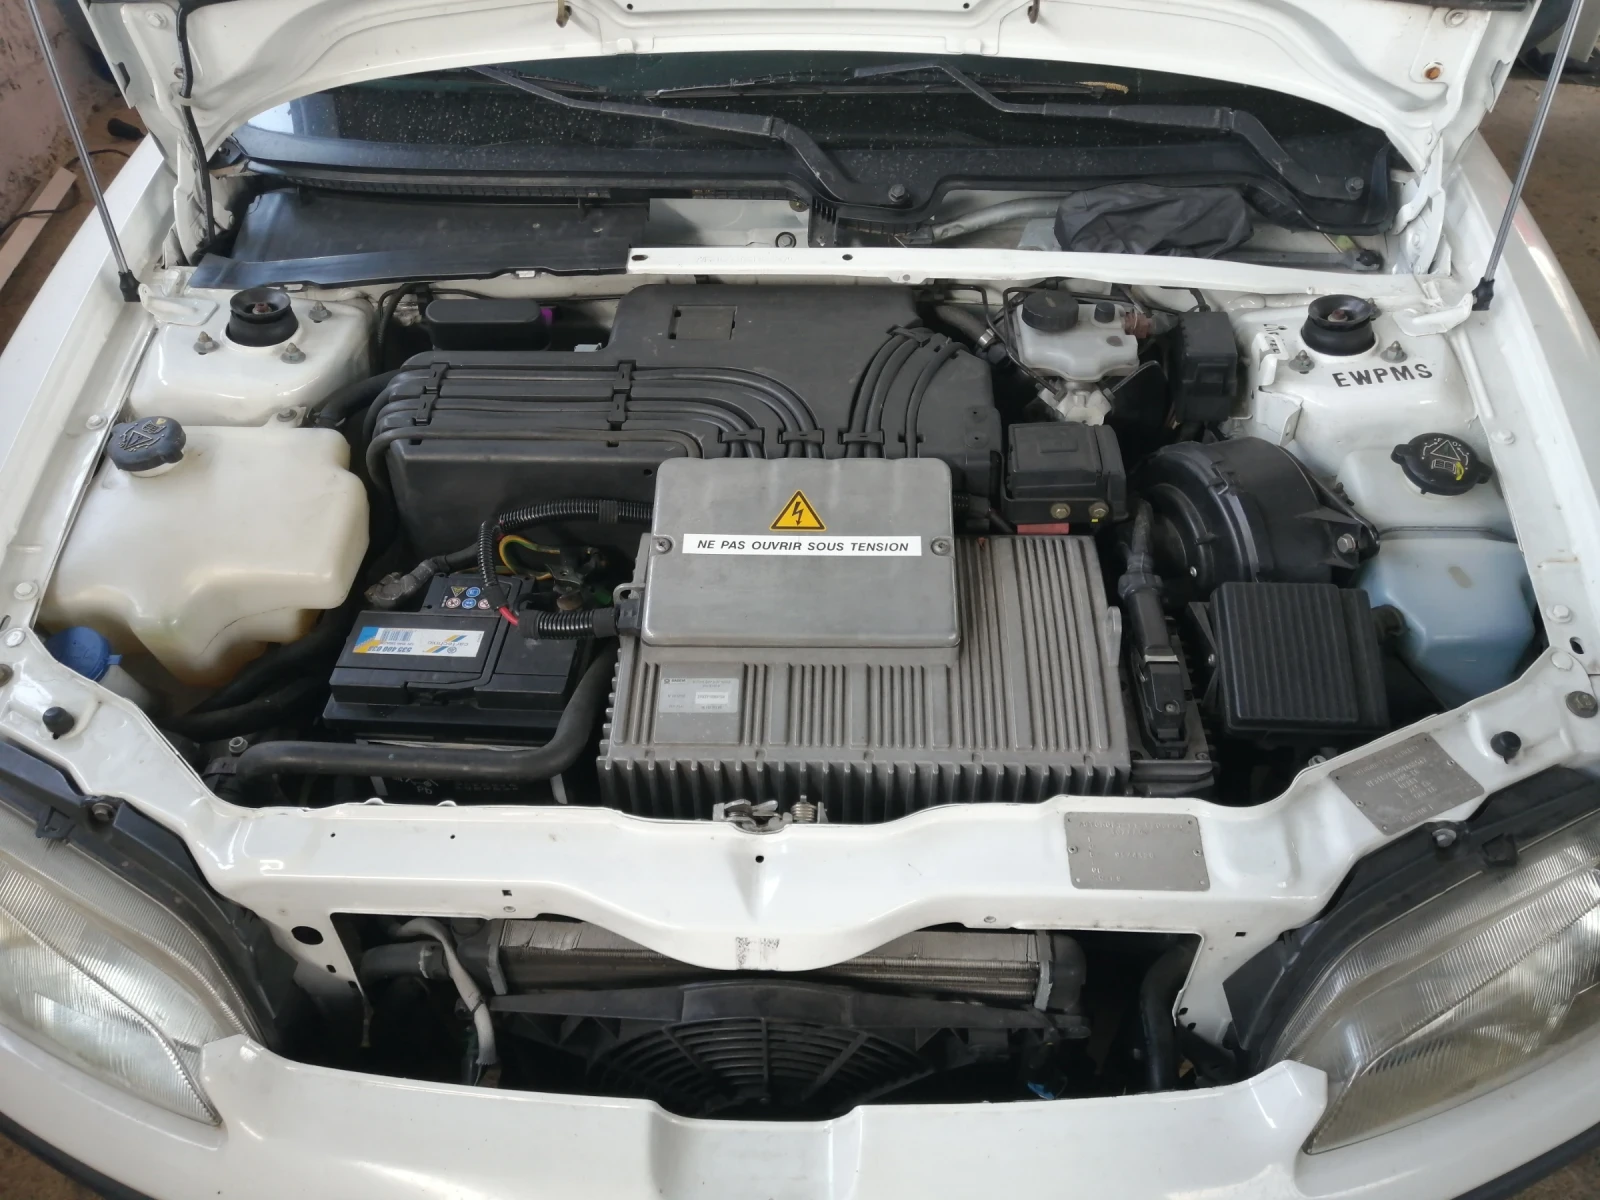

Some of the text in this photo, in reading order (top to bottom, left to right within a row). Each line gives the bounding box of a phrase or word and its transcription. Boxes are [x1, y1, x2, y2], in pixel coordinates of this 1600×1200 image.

[1332, 364, 1433, 387] EWPMS
[697, 539, 909, 552] NE PAS OUVRIR SOUS TENSION
